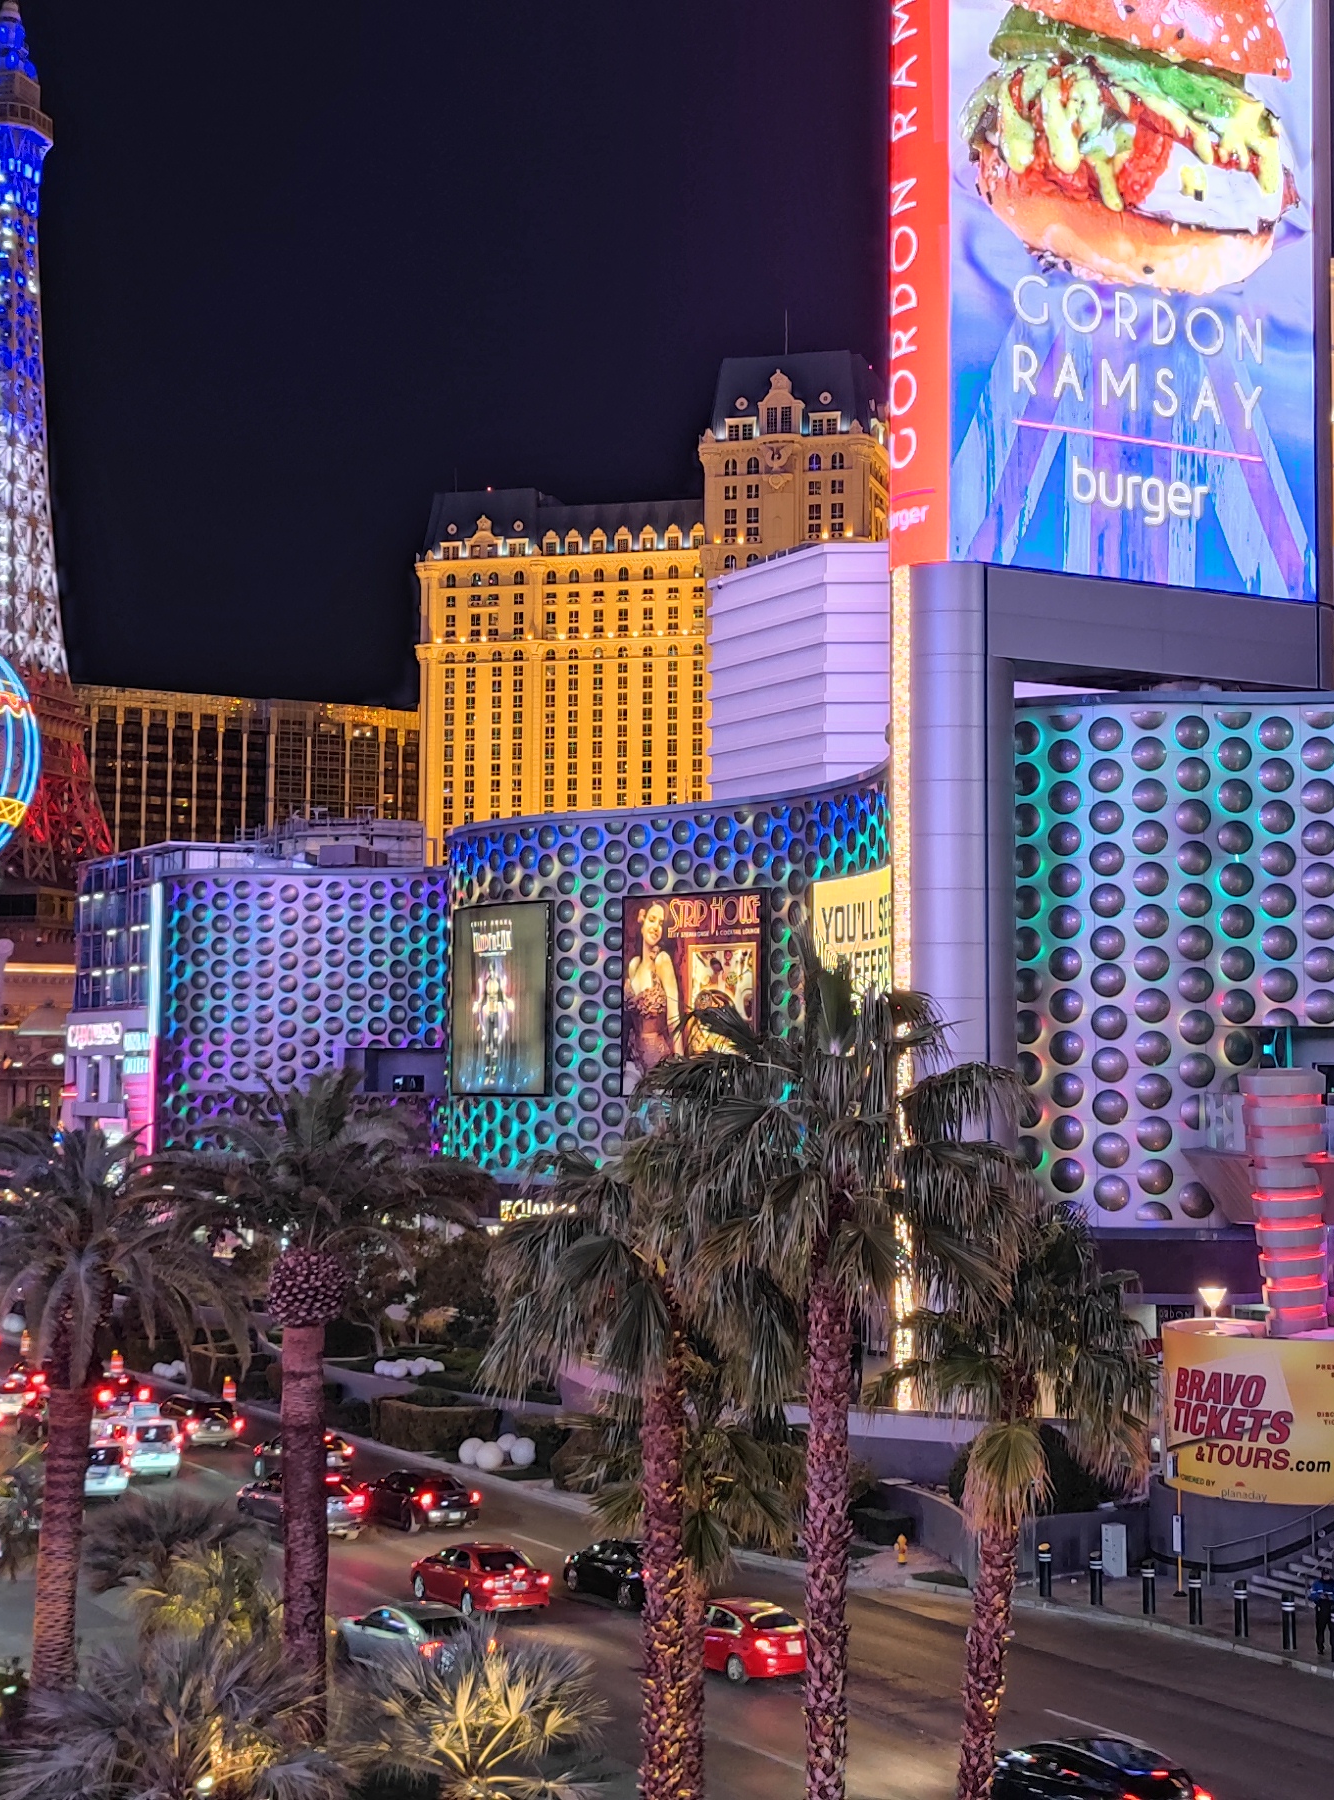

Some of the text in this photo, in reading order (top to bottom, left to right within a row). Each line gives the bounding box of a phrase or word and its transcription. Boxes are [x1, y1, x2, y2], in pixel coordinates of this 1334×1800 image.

[890, 177, 918, 470] GORDON
[1013, 274, 1263, 365] GORDON
[1012, 343, 1263, 430] RAMSAY
[1072, 455, 1209, 527] burger
[667, 894, 761, 935] STRIP HOUSE
[821, 899, 876, 945] YOU'LL
[1174, 1366, 1267, 1409] BRAVO
[1173, 1398, 1294, 1445] TICKETS
[1180, 1473, 1216, 1487] OWERED BY
[1221, 1488, 1268, 1502] planaday
